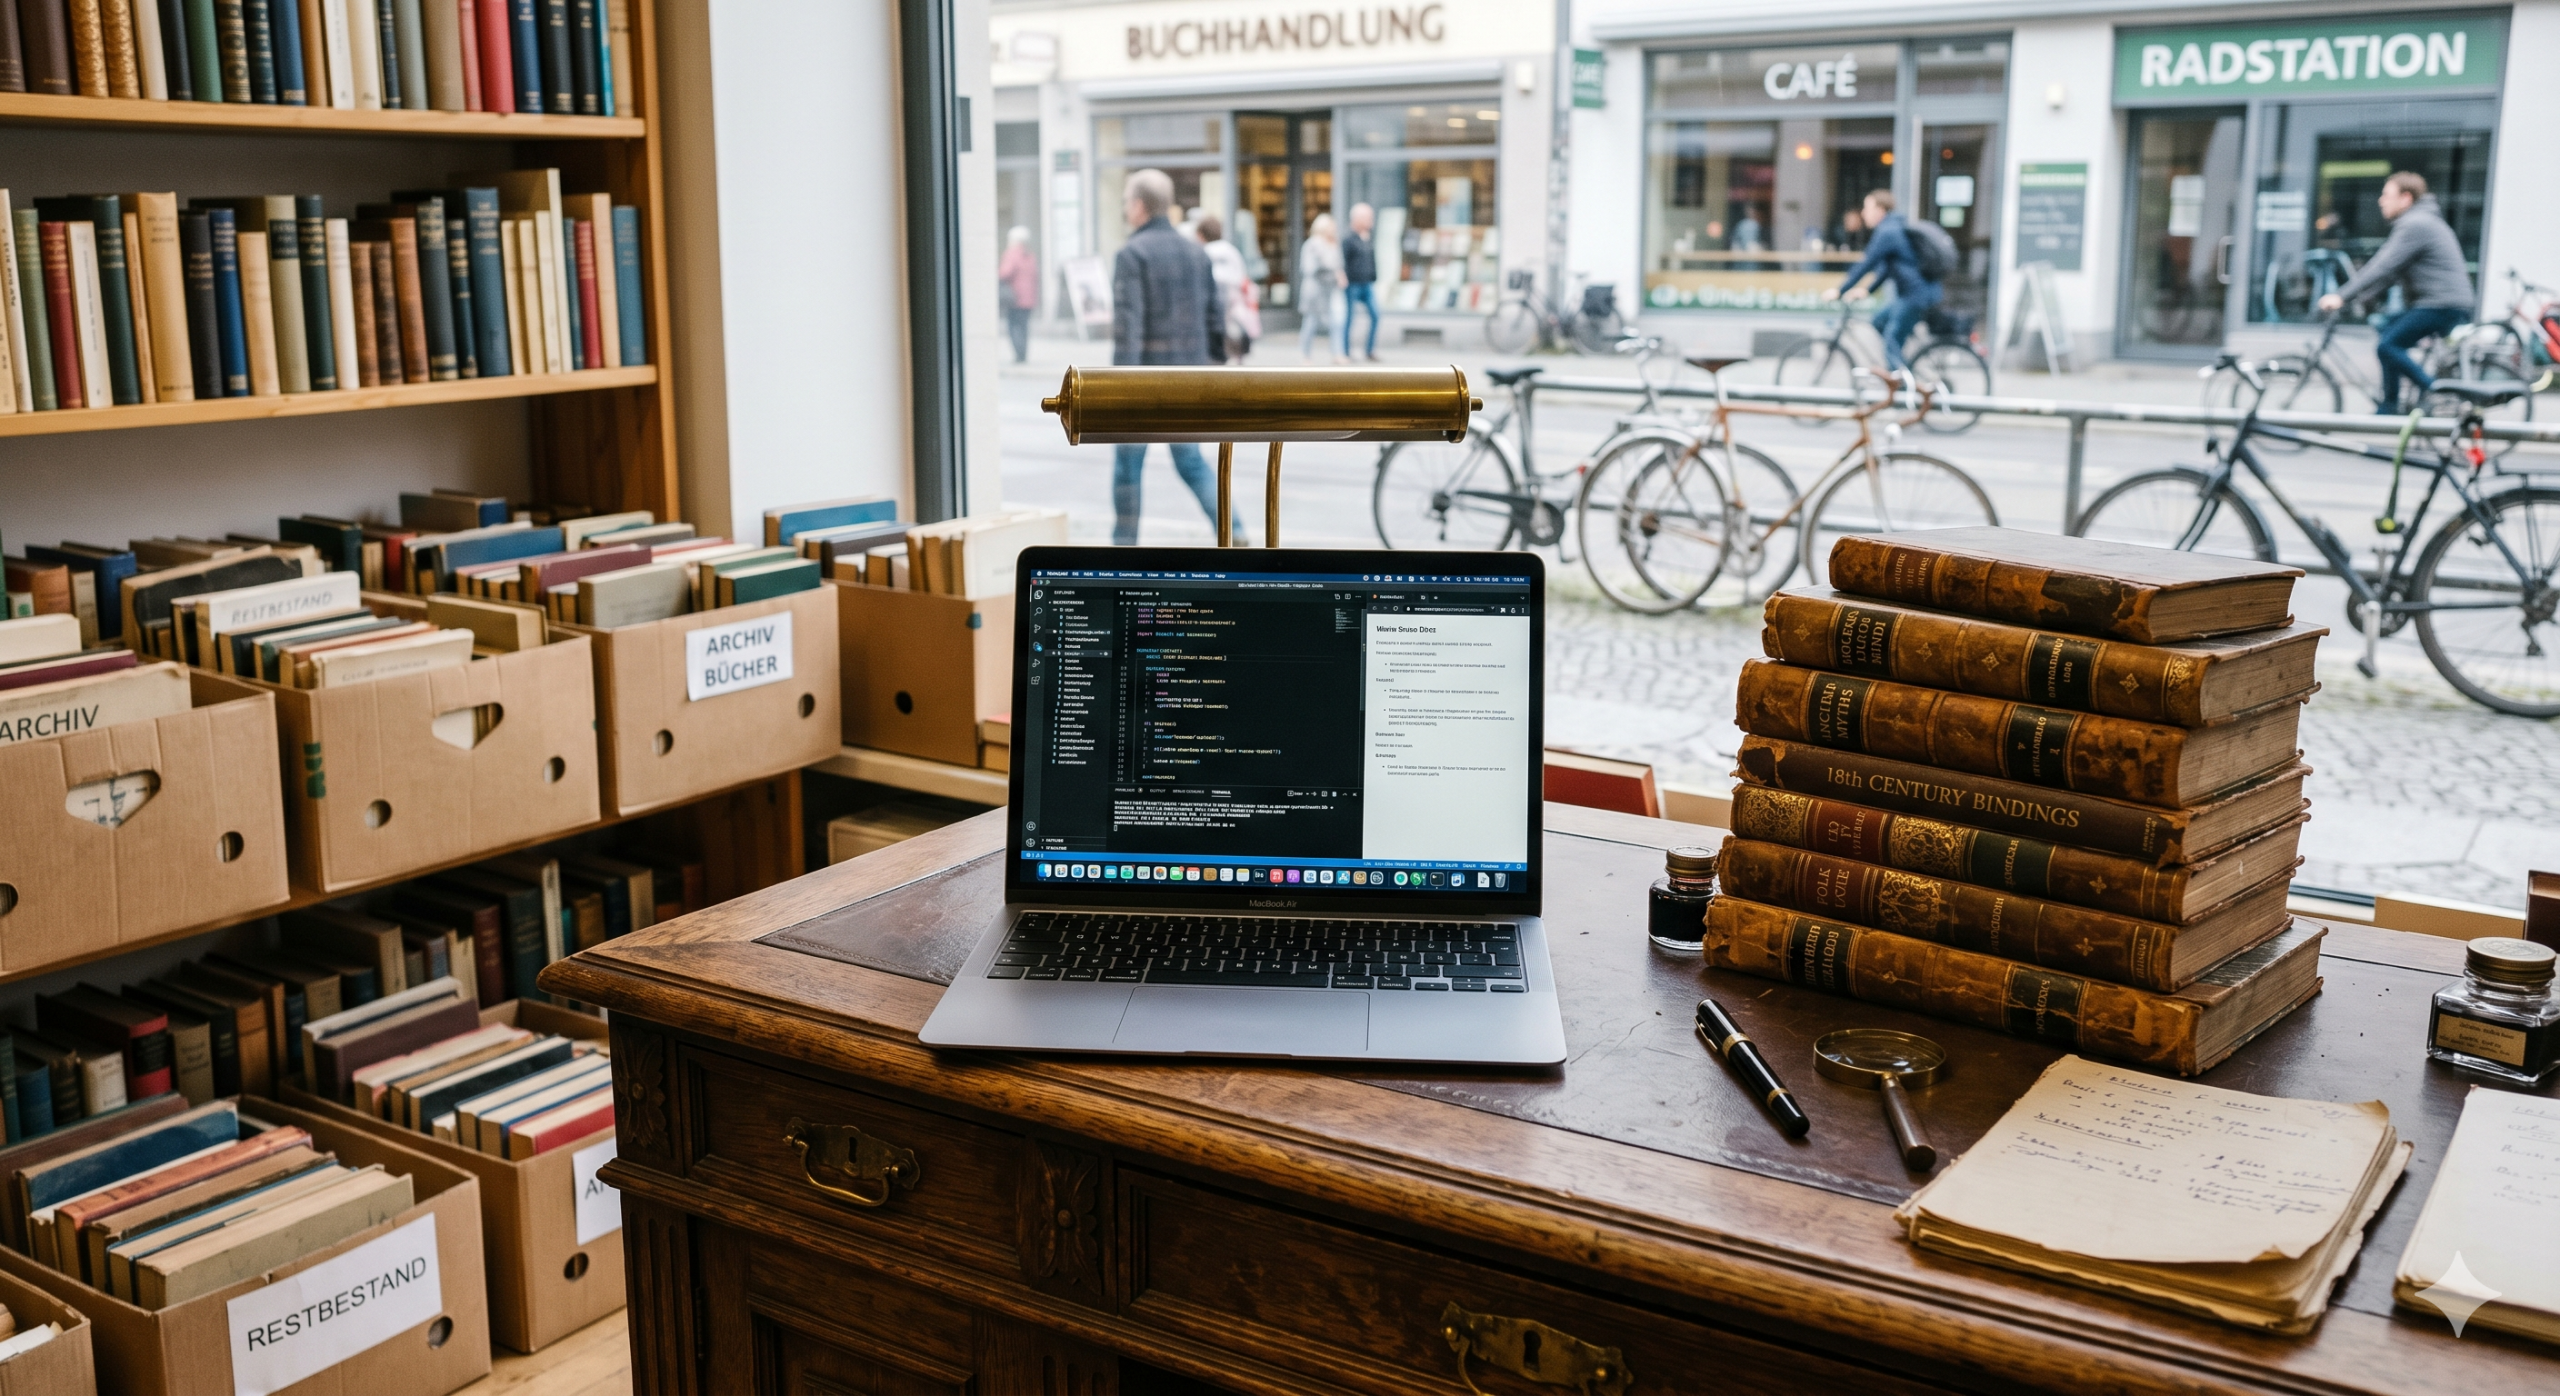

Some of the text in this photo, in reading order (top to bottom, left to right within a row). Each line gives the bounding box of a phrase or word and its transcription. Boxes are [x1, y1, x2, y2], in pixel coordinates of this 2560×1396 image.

[1126, 4, 1447, 60] BUCHHANDLUNG
[1764, 53, 1857, 100] CAFÉ
[2140, 31, 2468, 87] RADSTATION
[231, 590, 333, 626] RESTBESTAND
[706, 625, 775, 656] ARCHIV
[705, 655, 778, 688] BÜCHER
[0, 704, 99, 742] ARCHIV
[1827, 767, 2080, 828] 18th CENTURY BINDINGS
[1250, 900, 1298, 908] MacBook Air
[247, 1256, 426, 1352] RESTBESTAND
